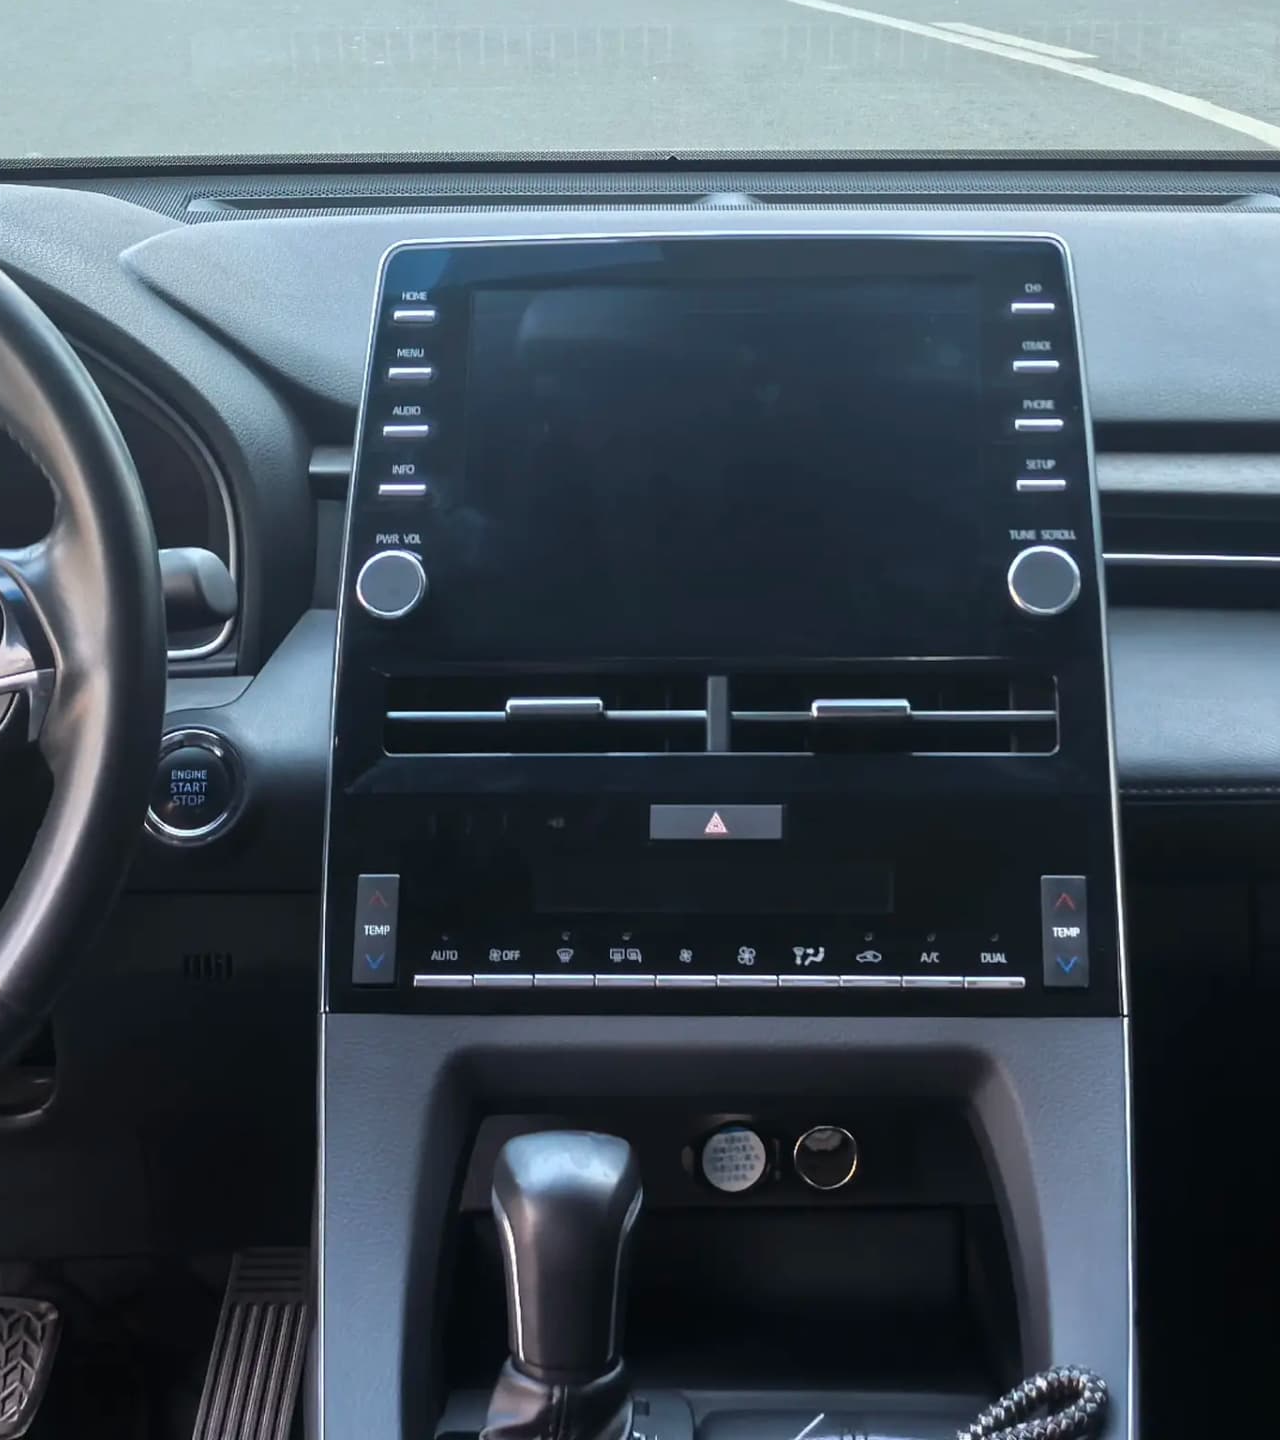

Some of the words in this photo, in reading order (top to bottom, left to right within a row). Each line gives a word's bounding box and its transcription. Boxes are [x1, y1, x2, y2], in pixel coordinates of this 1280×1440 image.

[401, 291, 428, 301] HOME
[396, 348, 425, 358] MENU
[392, 405, 421, 415] AUDIO
[392, 464, 415, 475] INFO
[376, 533, 400, 544] PWR
[403, 533, 421, 544] VOL
[171, 769, 208, 780] ENGINE
[170, 782, 208, 793] START
[173, 795, 206, 806] STOP
[363, 925, 391, 936] TEMP
[1052, 927, 1081, 938] TEMP
[431, 950, 459, 961] AUTO
[502, 950, 521, 961] OFF
[920, 952, 940, 963] A/C
[981, 952, 1008, 963] DUAL
